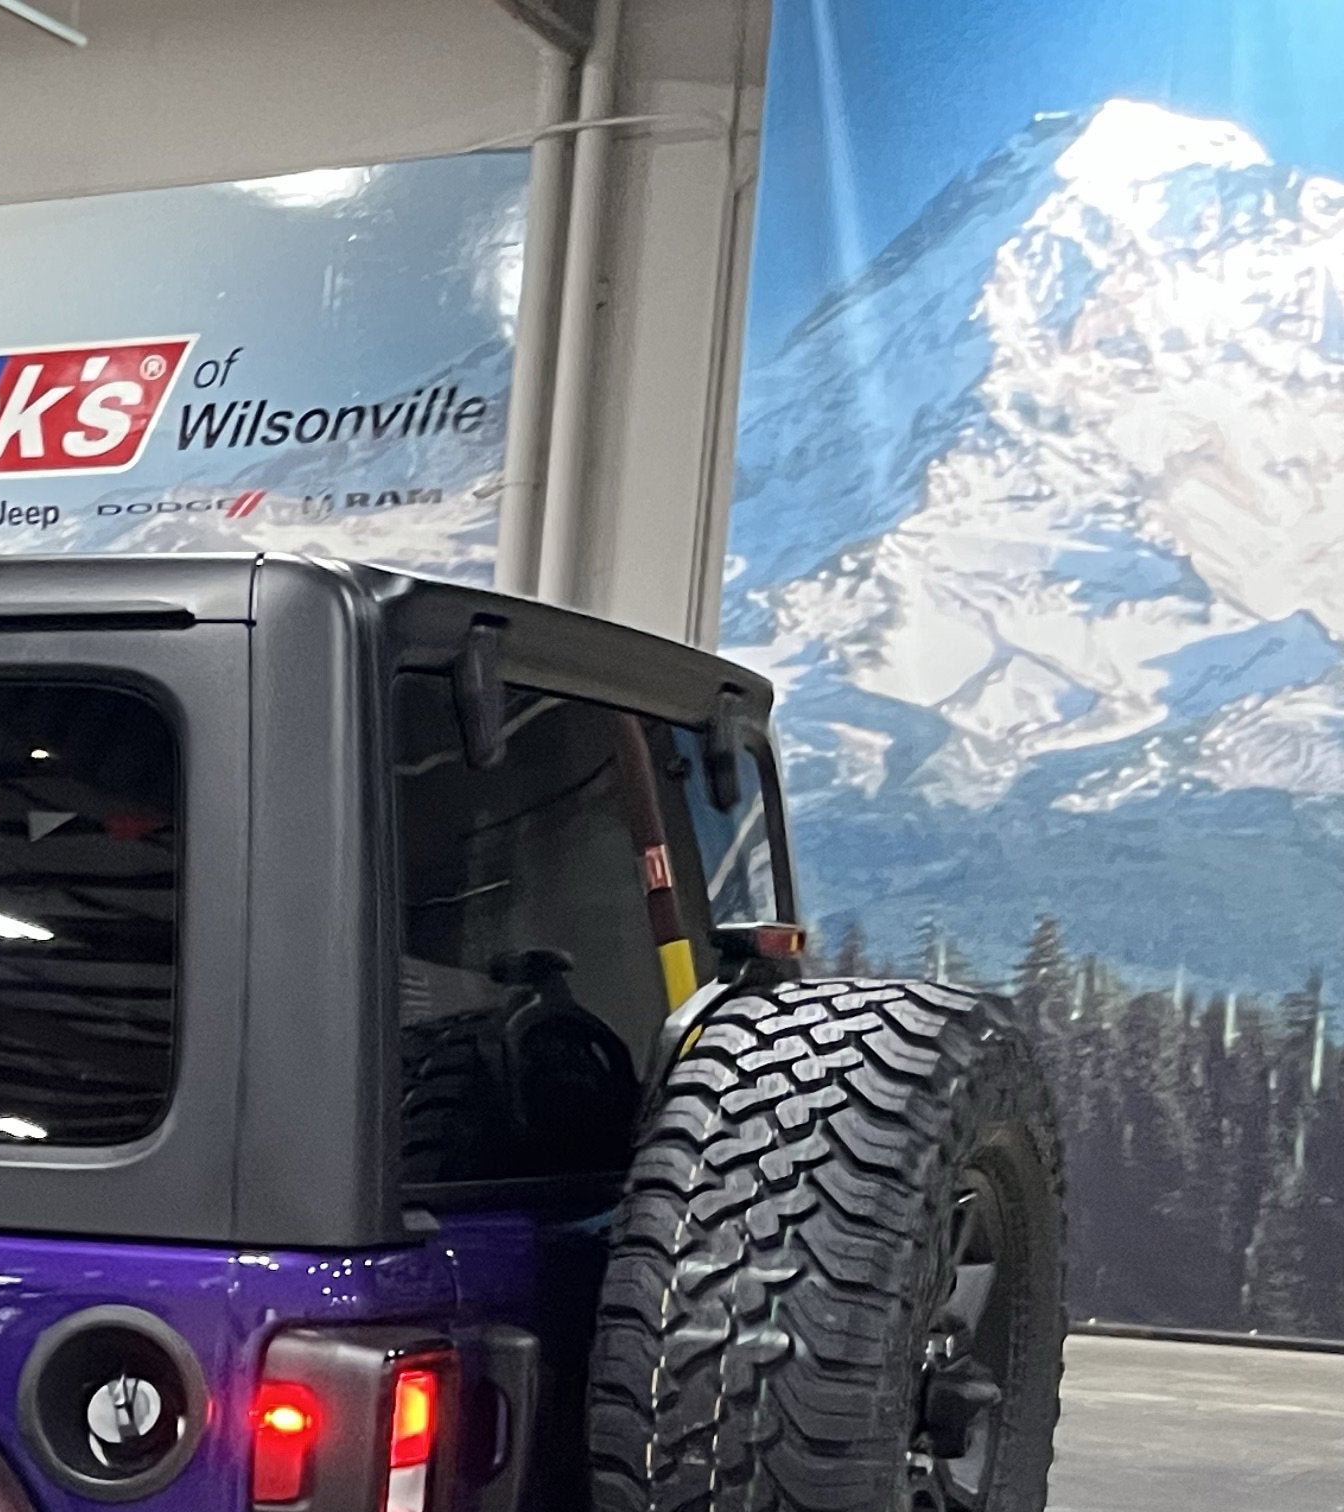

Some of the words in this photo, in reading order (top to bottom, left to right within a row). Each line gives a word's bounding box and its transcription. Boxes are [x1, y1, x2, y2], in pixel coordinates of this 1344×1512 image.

[193, 346, 244, 389] of
[177, 384, 487, 451] Wilsonville
[345, 488, 443, 508] RAM
